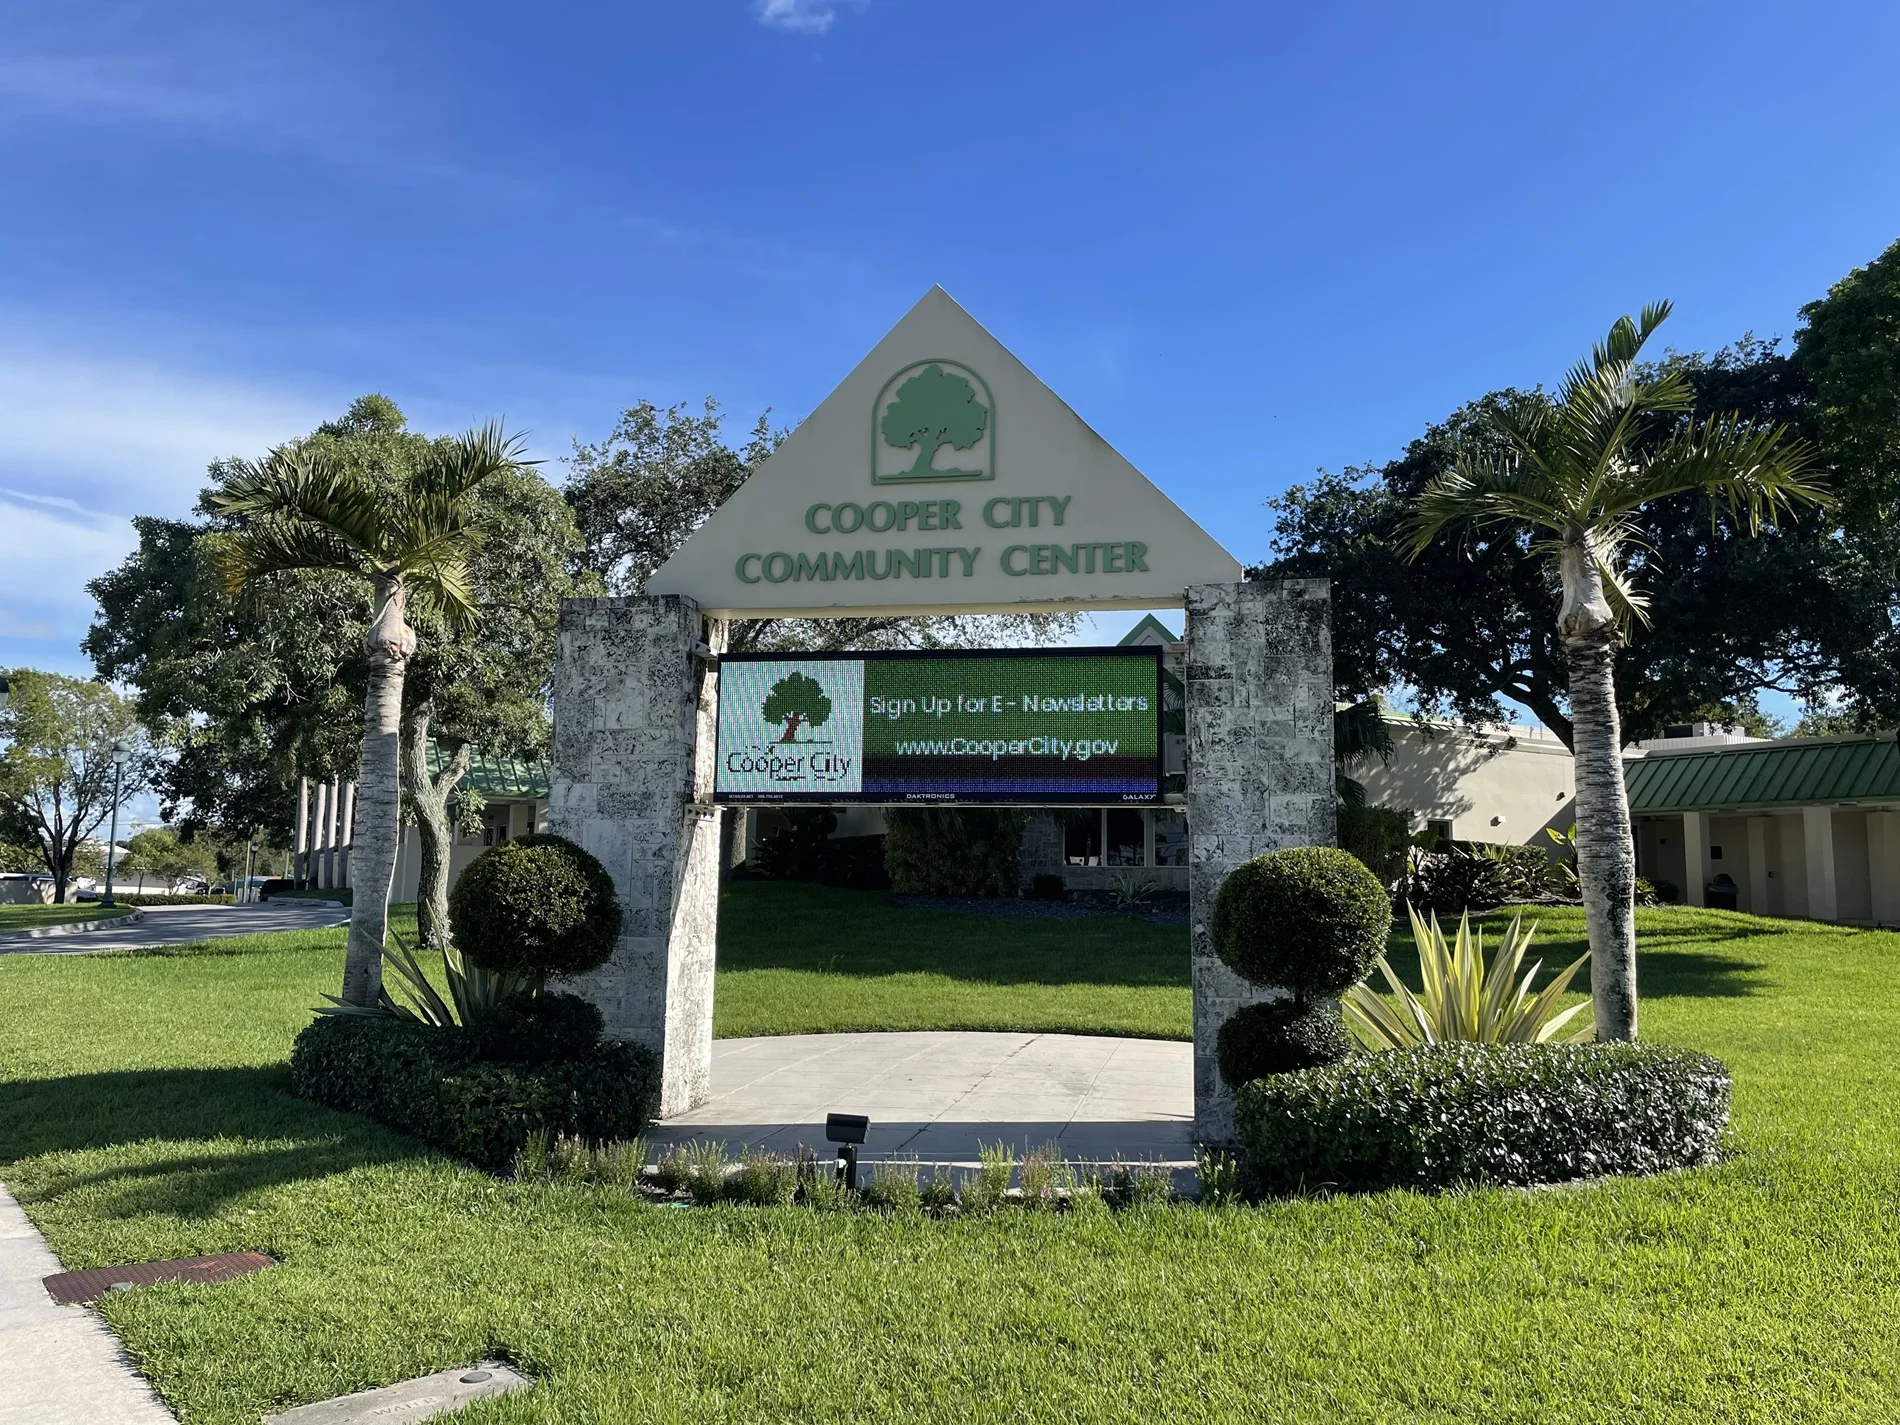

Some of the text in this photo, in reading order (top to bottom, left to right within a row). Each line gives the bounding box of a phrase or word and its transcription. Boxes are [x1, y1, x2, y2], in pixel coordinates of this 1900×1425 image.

[805, 495, 1072, 534] COOPER CITY
[735, 541, 1150, 583] COMMUNITY CENTER
[870, 695, 916, 720] Sign
[923, 696, 951, 719] Up
[958, 695, 987, 712] for
[1022, 693, 1149, 712] Newsletters
[895, 736, 1118, 761] www.CooperCity.gov
[726, 751, 851, 779] Cooper City
[373, 1396, 438, 1416] WATER
